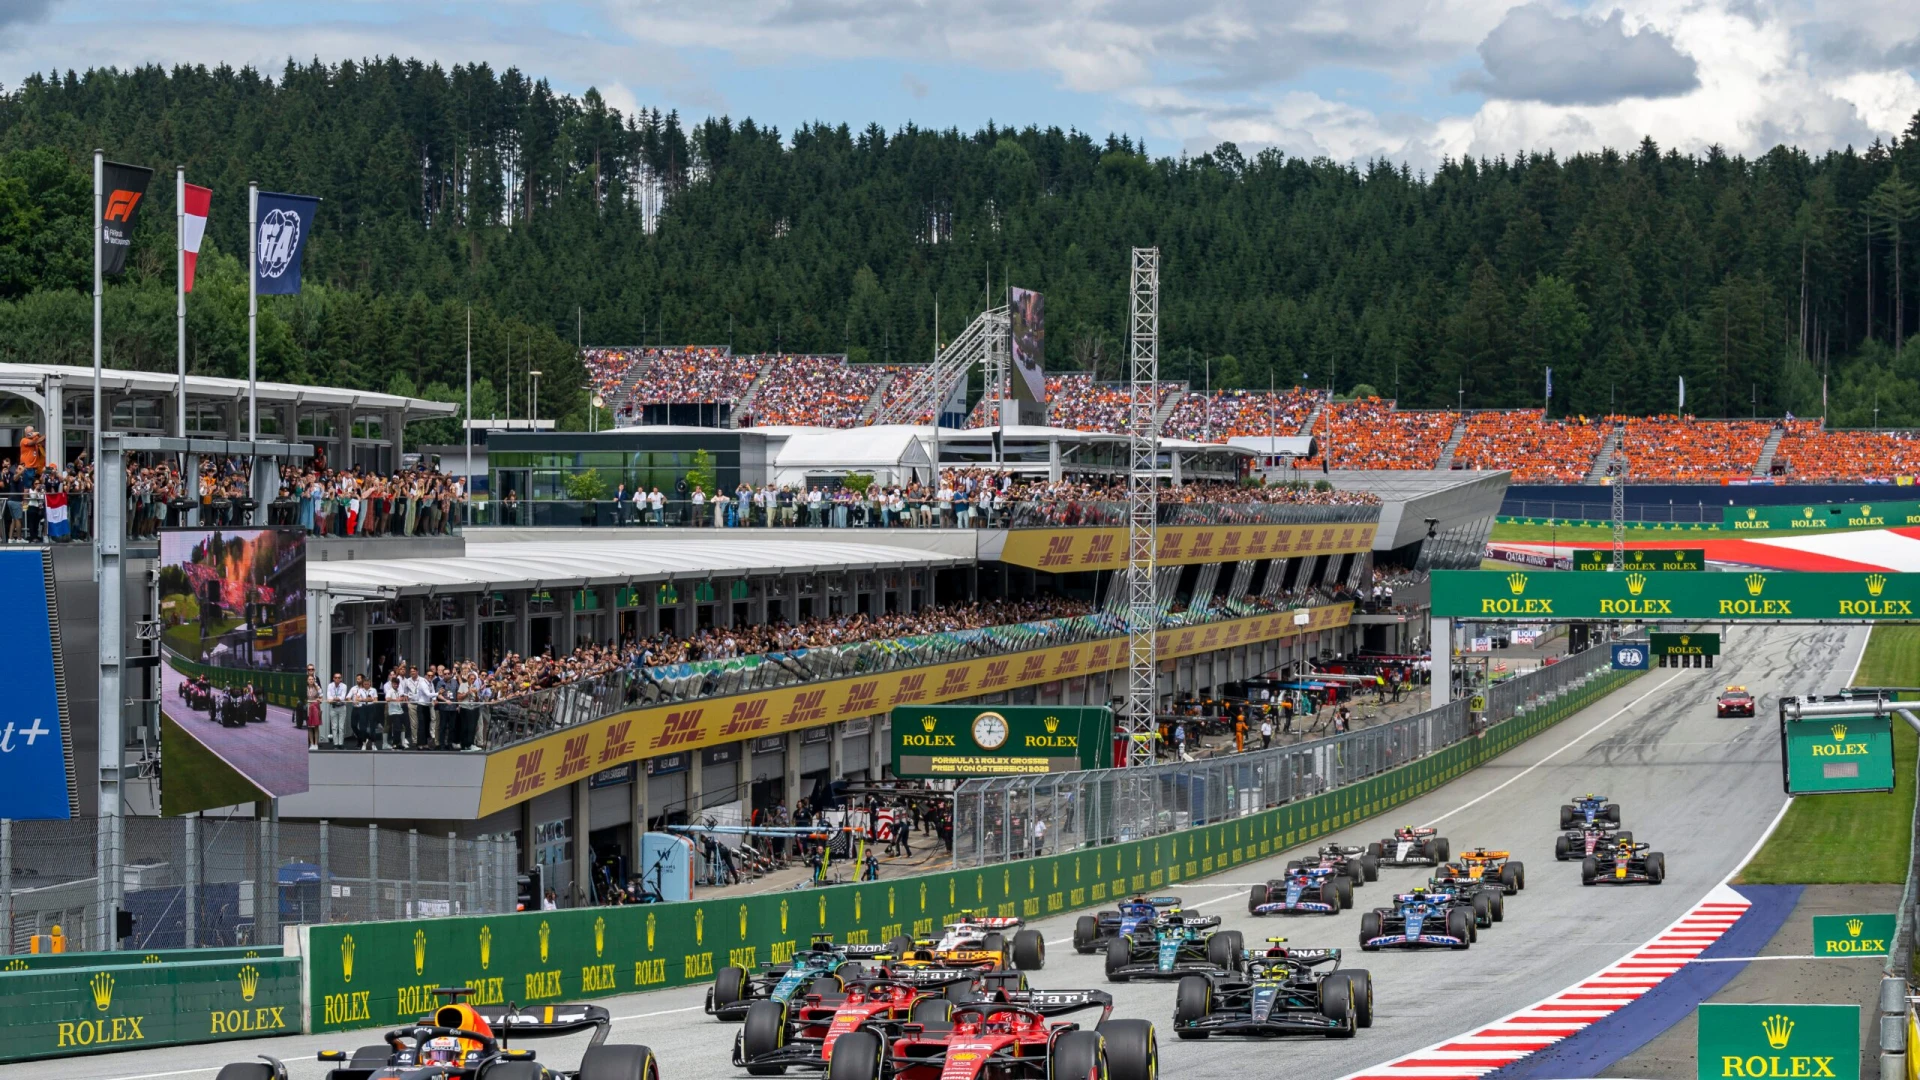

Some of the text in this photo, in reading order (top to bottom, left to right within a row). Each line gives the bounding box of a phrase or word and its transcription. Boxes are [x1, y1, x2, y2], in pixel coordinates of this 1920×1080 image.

[104, 189, 143, 223] F1
[1734, 520, 1769, 529] ROLEX
[1791, 519, 1827, 528] ROLEX
[1848, 516, 1884, 526] ROLEX
[1581, 563, 1608, 571] ROLE
[1663, 562, 1697, 570] ROLEX
[1482, 599, 1553, 614] ROLEX
[1600, 599, 1672, 614] ROLEX
[1719, 599, 1791, 615] ROLEX
[1839, 600, 1912, 615] ROLEX
[1668, 646, 1703, 654] ROLEX
[0, 718, 50, 753] t+
[903, 735, 956, 746] ROLEX
[1025, 735, 1078, 747] ROLEX
[1812, 743, 1868, 756] ROLEX
[771, 939, 797, 965] ROLEX
[1826, 939, 1885, 953] ROLEX
[685, 952, 714, 979] ROLEX
[729, 946, 757, 970] ROLEX
[582, 963, 616, 992] ROLEX
[635, 957, 666, 986] ROLEX
[466, 976, 505, 1007] ROLEX
[525, 969, 563, 1000] ROLEX
[324, 990, 372, 1025] ROLEX
[397, 983, 441, 1016] ROLEX
[211, 1006, 285, 1034] ROLEX
[58, 1016, 145, 1048] ROLEX
[1721, 1055, 1836, 1078] ROLEX
